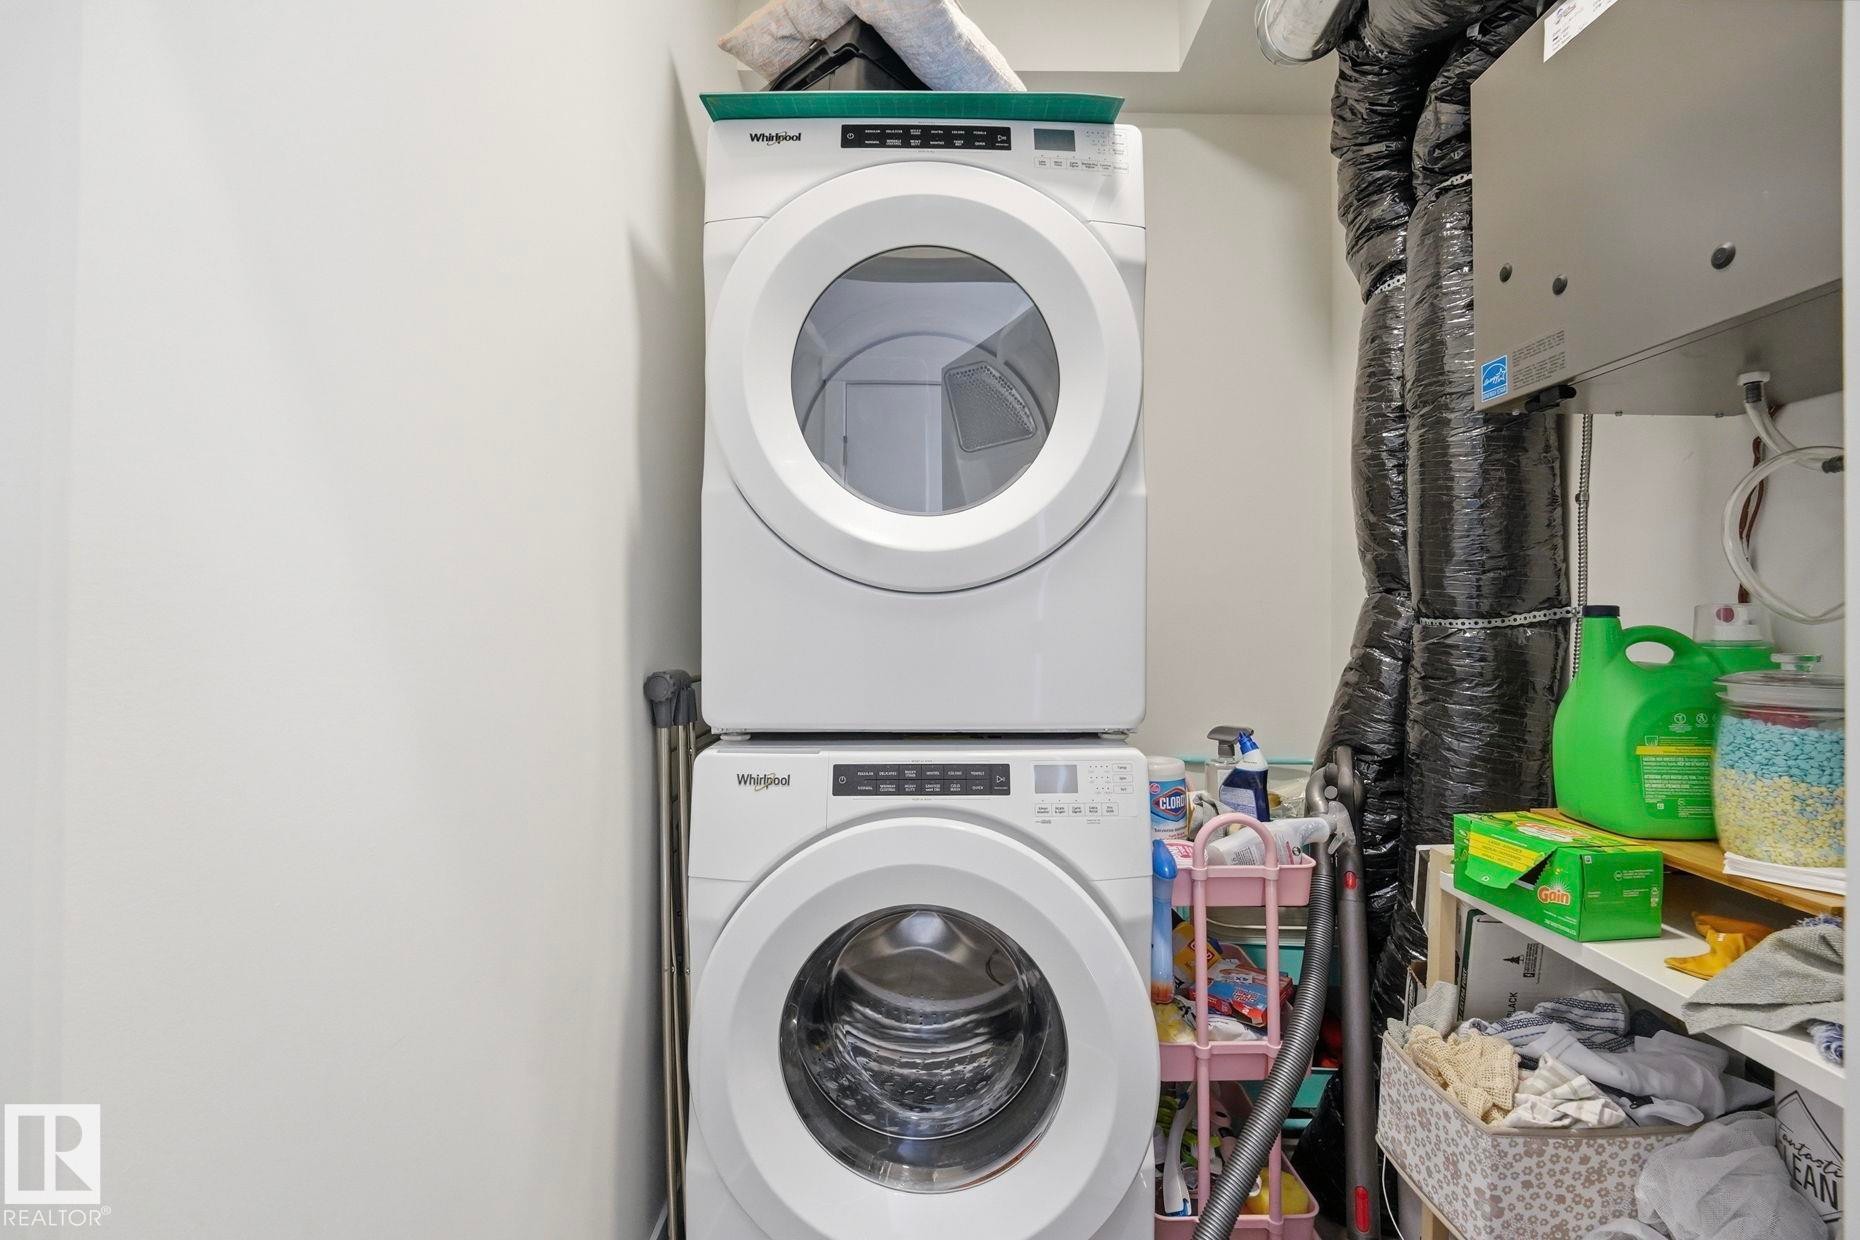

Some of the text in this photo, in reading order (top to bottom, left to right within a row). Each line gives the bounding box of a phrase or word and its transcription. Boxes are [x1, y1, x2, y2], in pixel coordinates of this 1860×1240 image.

[749, 131, 802, 145] Whirlpool
[736, 773, 791, 791] Whirlpool
[1159, 794, 1186, 810] CLORO
[1538, 886, 1571, 905] Gain
[1506, 992, 1518, 1018] BLACK
[1777, 1119, 1844, 1179] Fantasti
